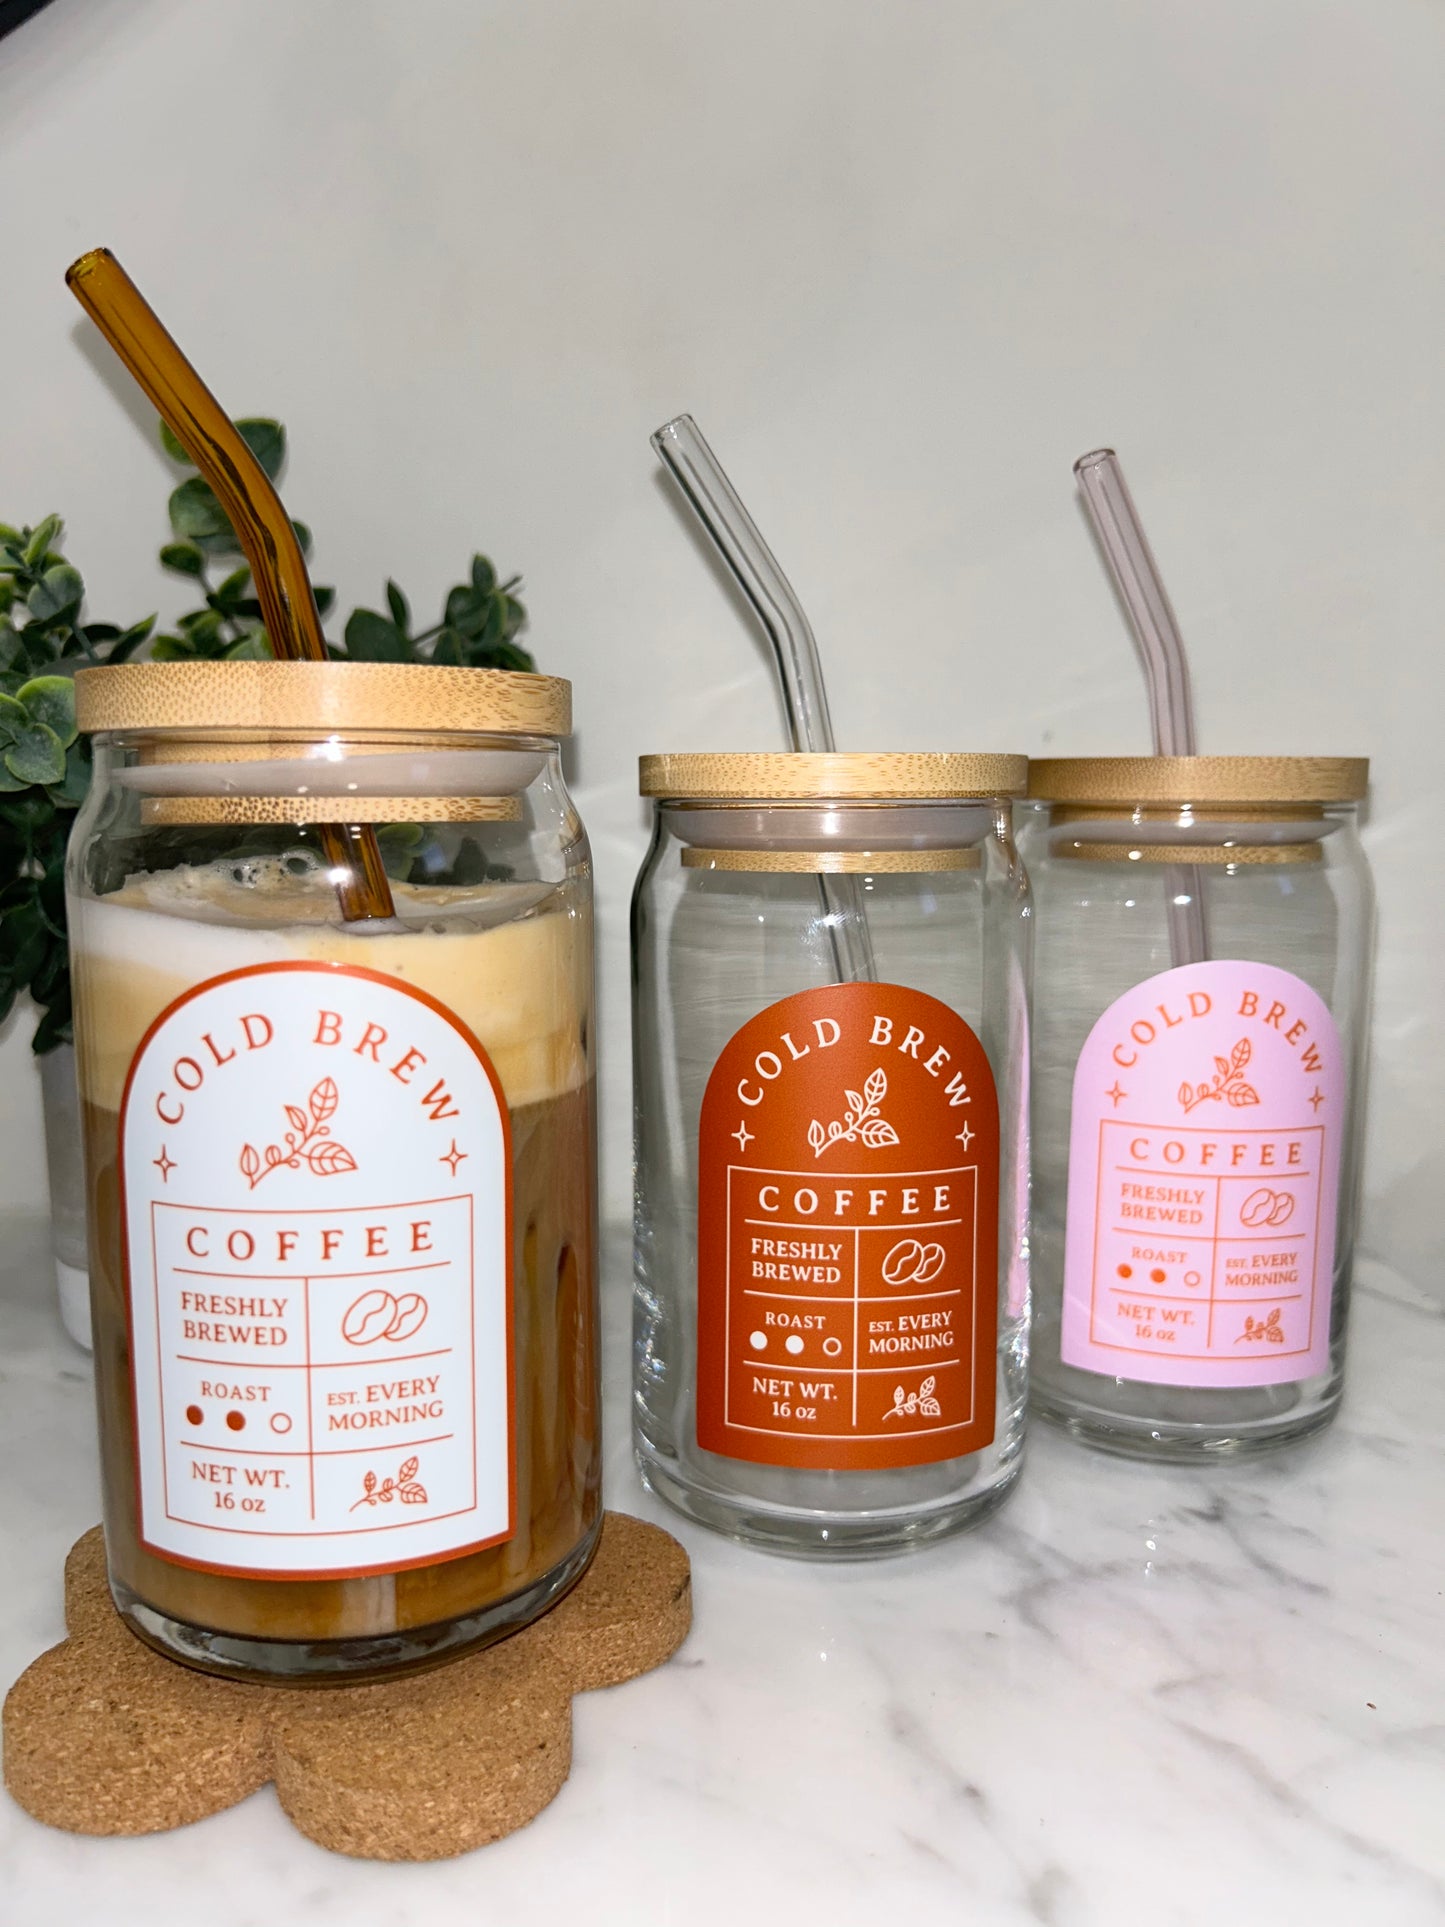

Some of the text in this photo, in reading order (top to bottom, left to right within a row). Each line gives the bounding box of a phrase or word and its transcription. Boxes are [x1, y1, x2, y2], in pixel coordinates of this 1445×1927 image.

[1113, 991, 1323, 1074] COLD BREW
[155, 1010, 459, 1126] COLD BREW
[737, 1015, 971, 1107] COLD BREW
[1130, 1138, 1302, 1166] COFFEE
[759, 1185, 951, 1215] COFFEE
[1121, 1183, 1204, 1205] FRESHLY
[1121, 1203, 1202, 1225] BREWED
[186, 1221, 433, 1261] COFFEE
[751, 1238, 842, 1262] FRESHLY
[1131, 1247, 1187, 1263] ROAST
[1226, 1253, 1298, 1268] EST. EVERY
[752, 1262, 841, 1284] BREWED
[1225, 1269, 1298, 1286] MORNING
[181, 1291, 288, 1318] FRESHLY
[1117, 1303, 1195, 1325] NET WT.
[765, 1311, 826, 1329] ROAST
[868, 1311, 953, 1332] EST. EVERY
[183, 1319, 287, 1347] BREWED
[868, 1331, 954, 1353] MORNING
[1135, 1325, 1175, 1342] 16 oz
[201, 1381, 271, 1402] ROAST
[327, 1375, 441, 1406] EST. EVERY
[753, 1377, 837, 1400] NET WT.
[328, 1400, 444, 1432] MORNING
[772, 1402, 816, 1420] 16 oz
[191, 1461, 290, 1489] NET WT.
[215, 1492, 266, 1513] 16 oz
